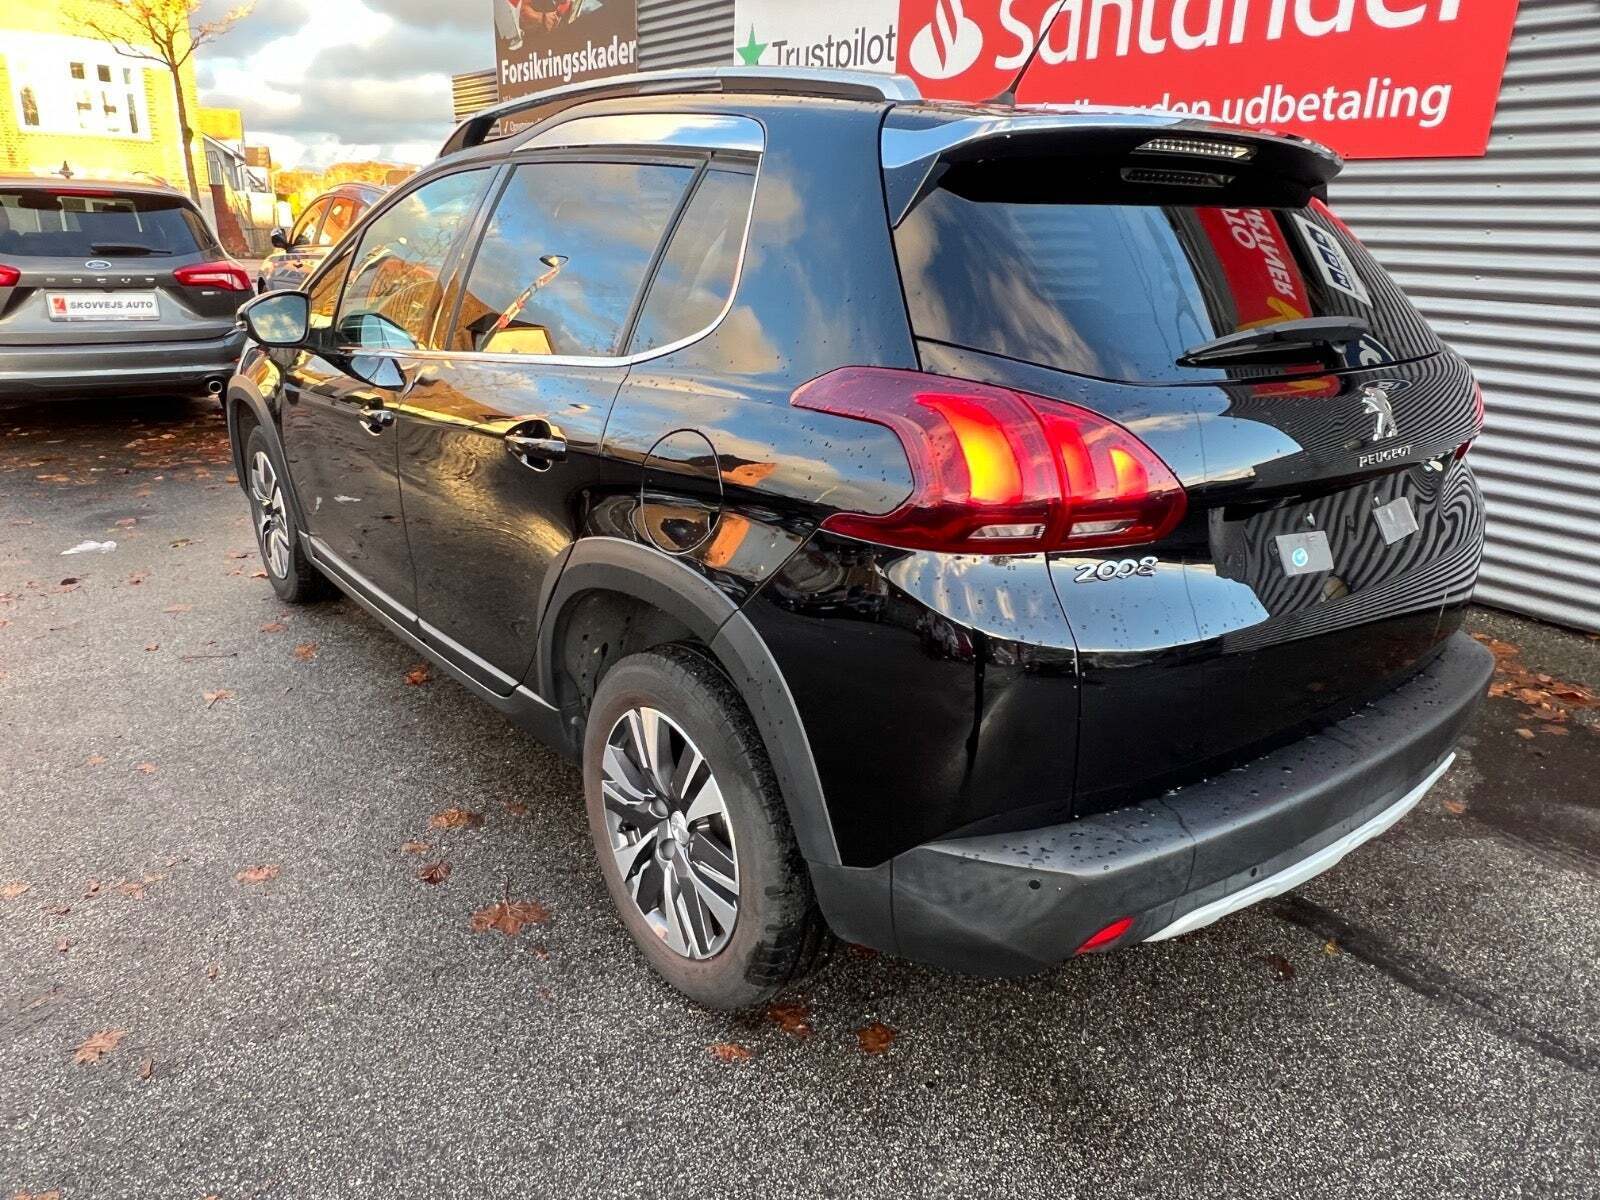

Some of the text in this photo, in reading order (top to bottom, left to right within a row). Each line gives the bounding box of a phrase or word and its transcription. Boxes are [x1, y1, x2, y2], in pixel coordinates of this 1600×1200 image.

[501, 34, 637, 85] Forsikringsskader
[1221, 77, 1452, 128] udbetaling
[126, 301, 154, 309] AUTO
[1359, 445, 1412, 468] PEUGEOT
[1073, 556, 1159, 584] 2008
